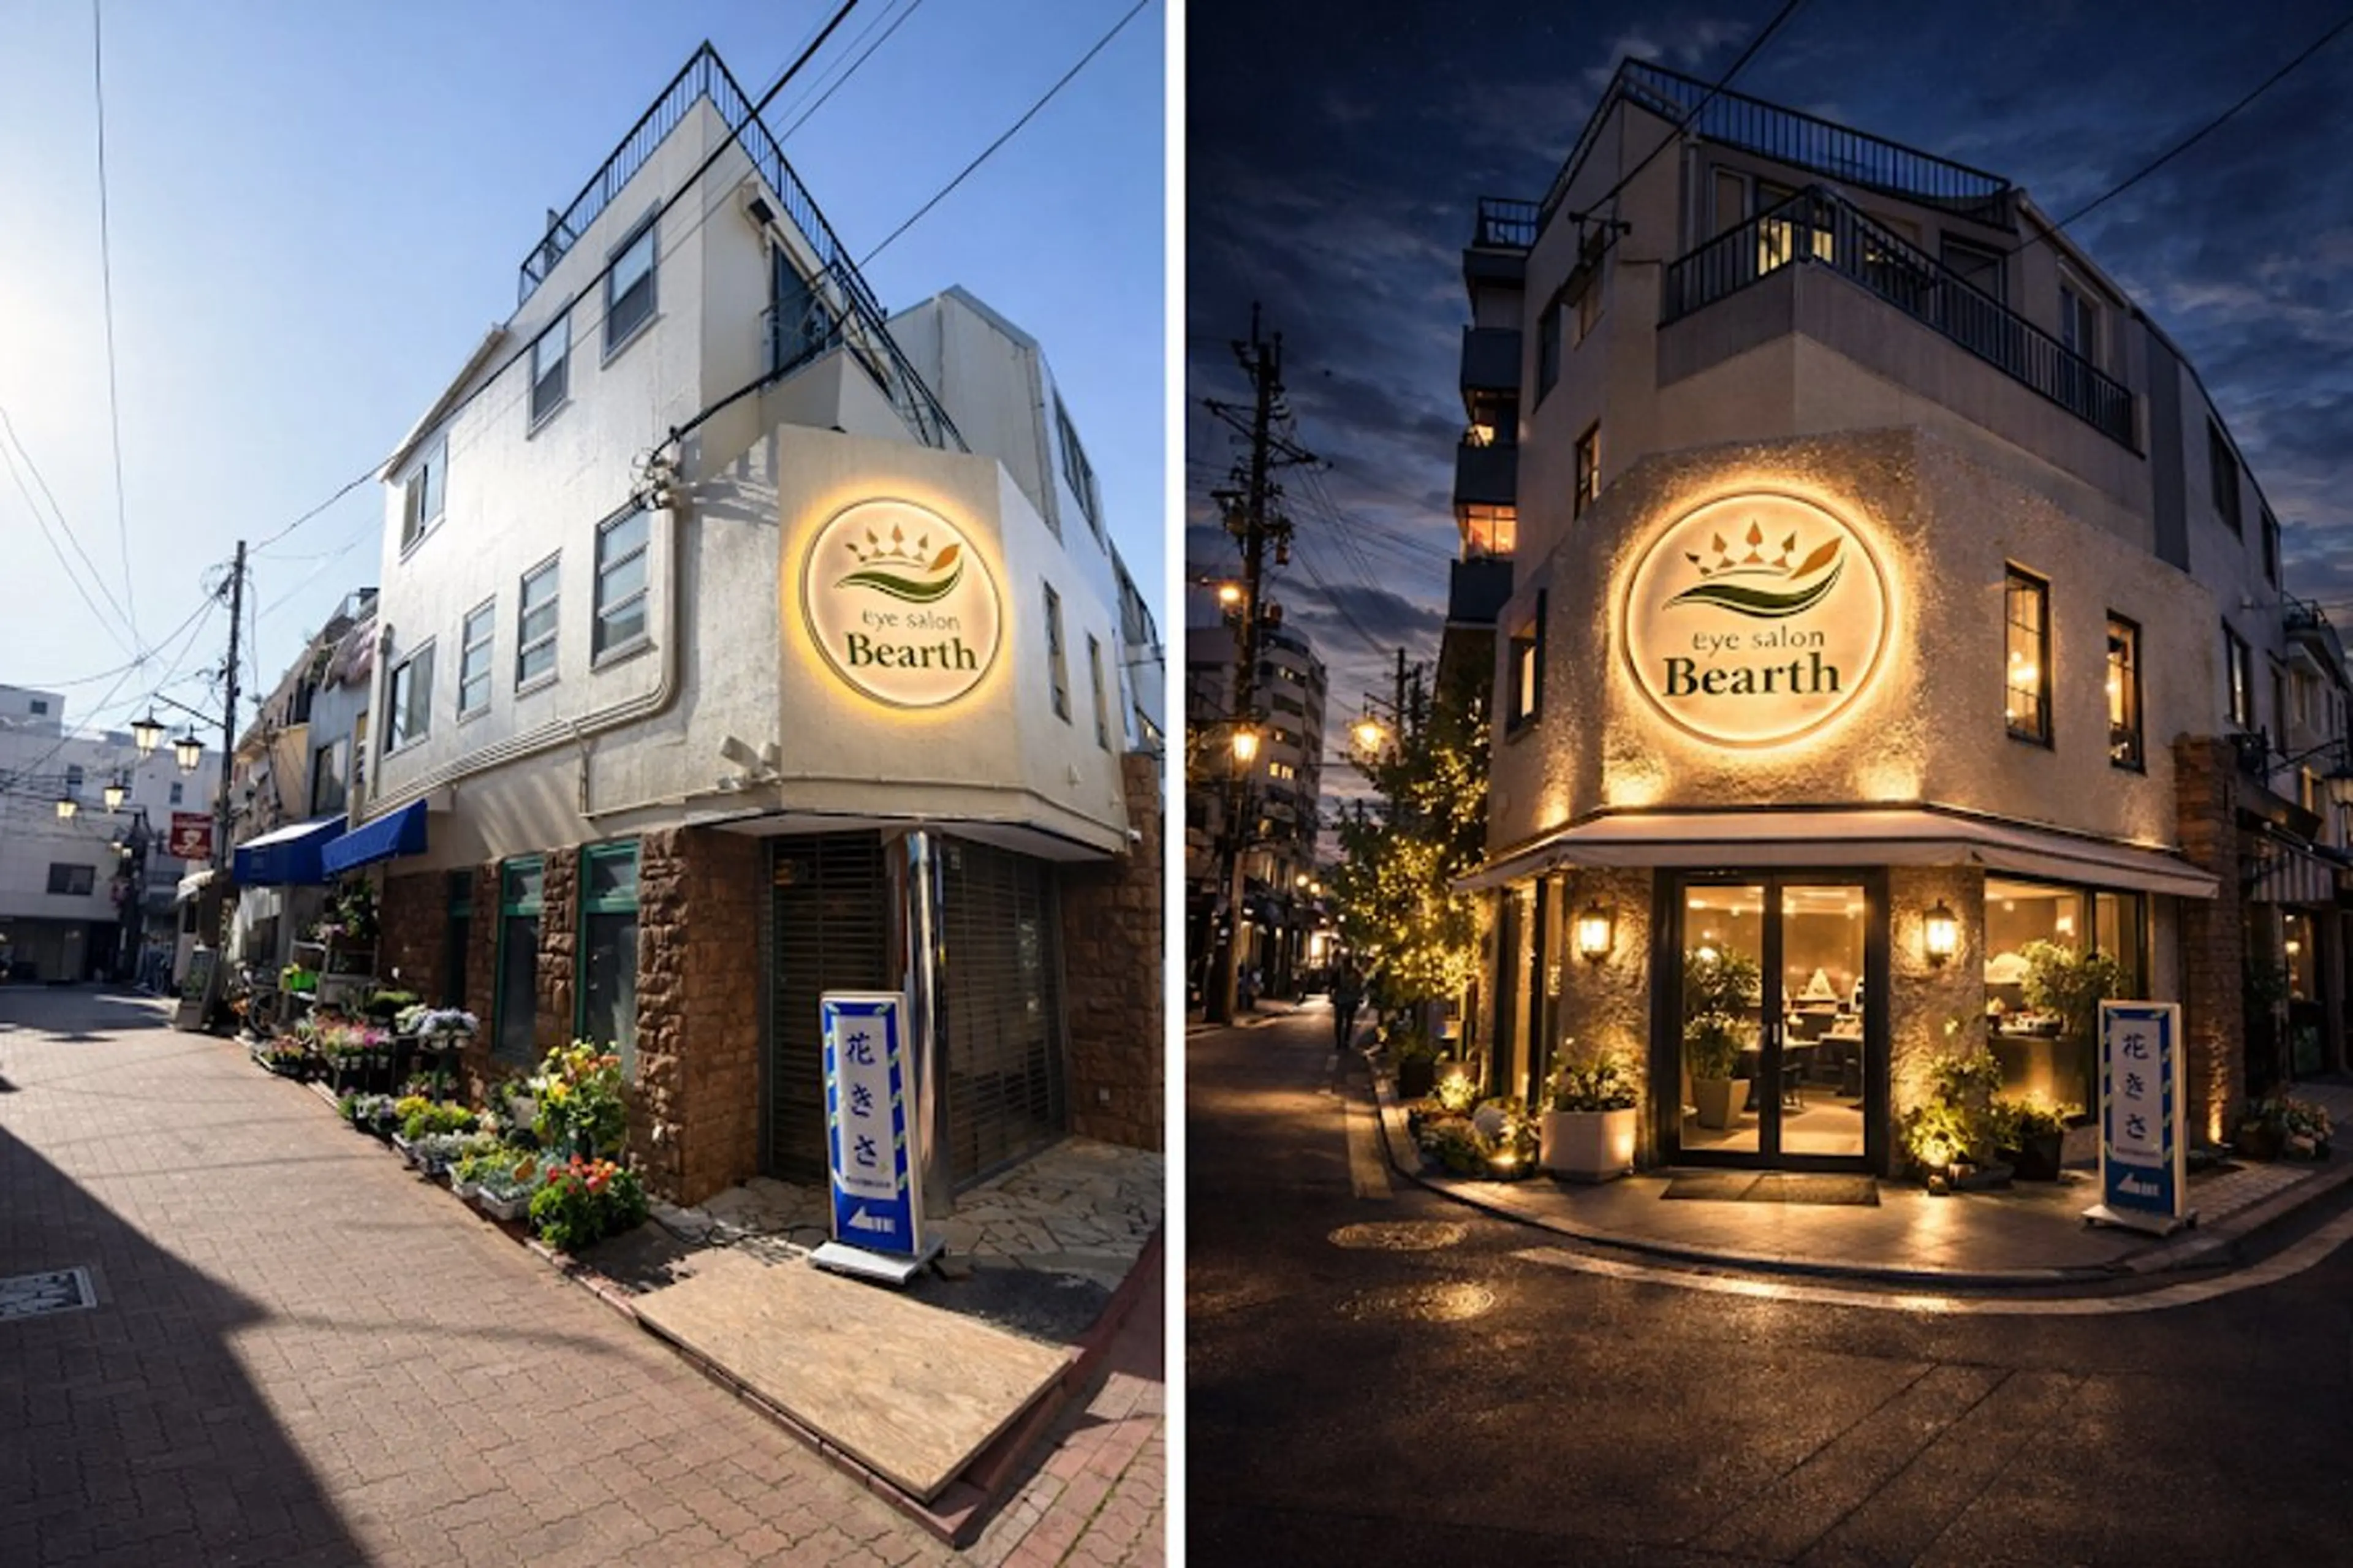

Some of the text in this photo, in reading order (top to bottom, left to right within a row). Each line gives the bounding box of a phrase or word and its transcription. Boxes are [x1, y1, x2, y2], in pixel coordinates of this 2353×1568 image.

[862, 609, 961, 631] eye salon
[845, 632, 979, 670] Bearth
[1692, 625, 1825, 657] eye salon
[1662, 652, 1842, 697] Bearth
[845, 1032, 876, 1167] 花きさ
